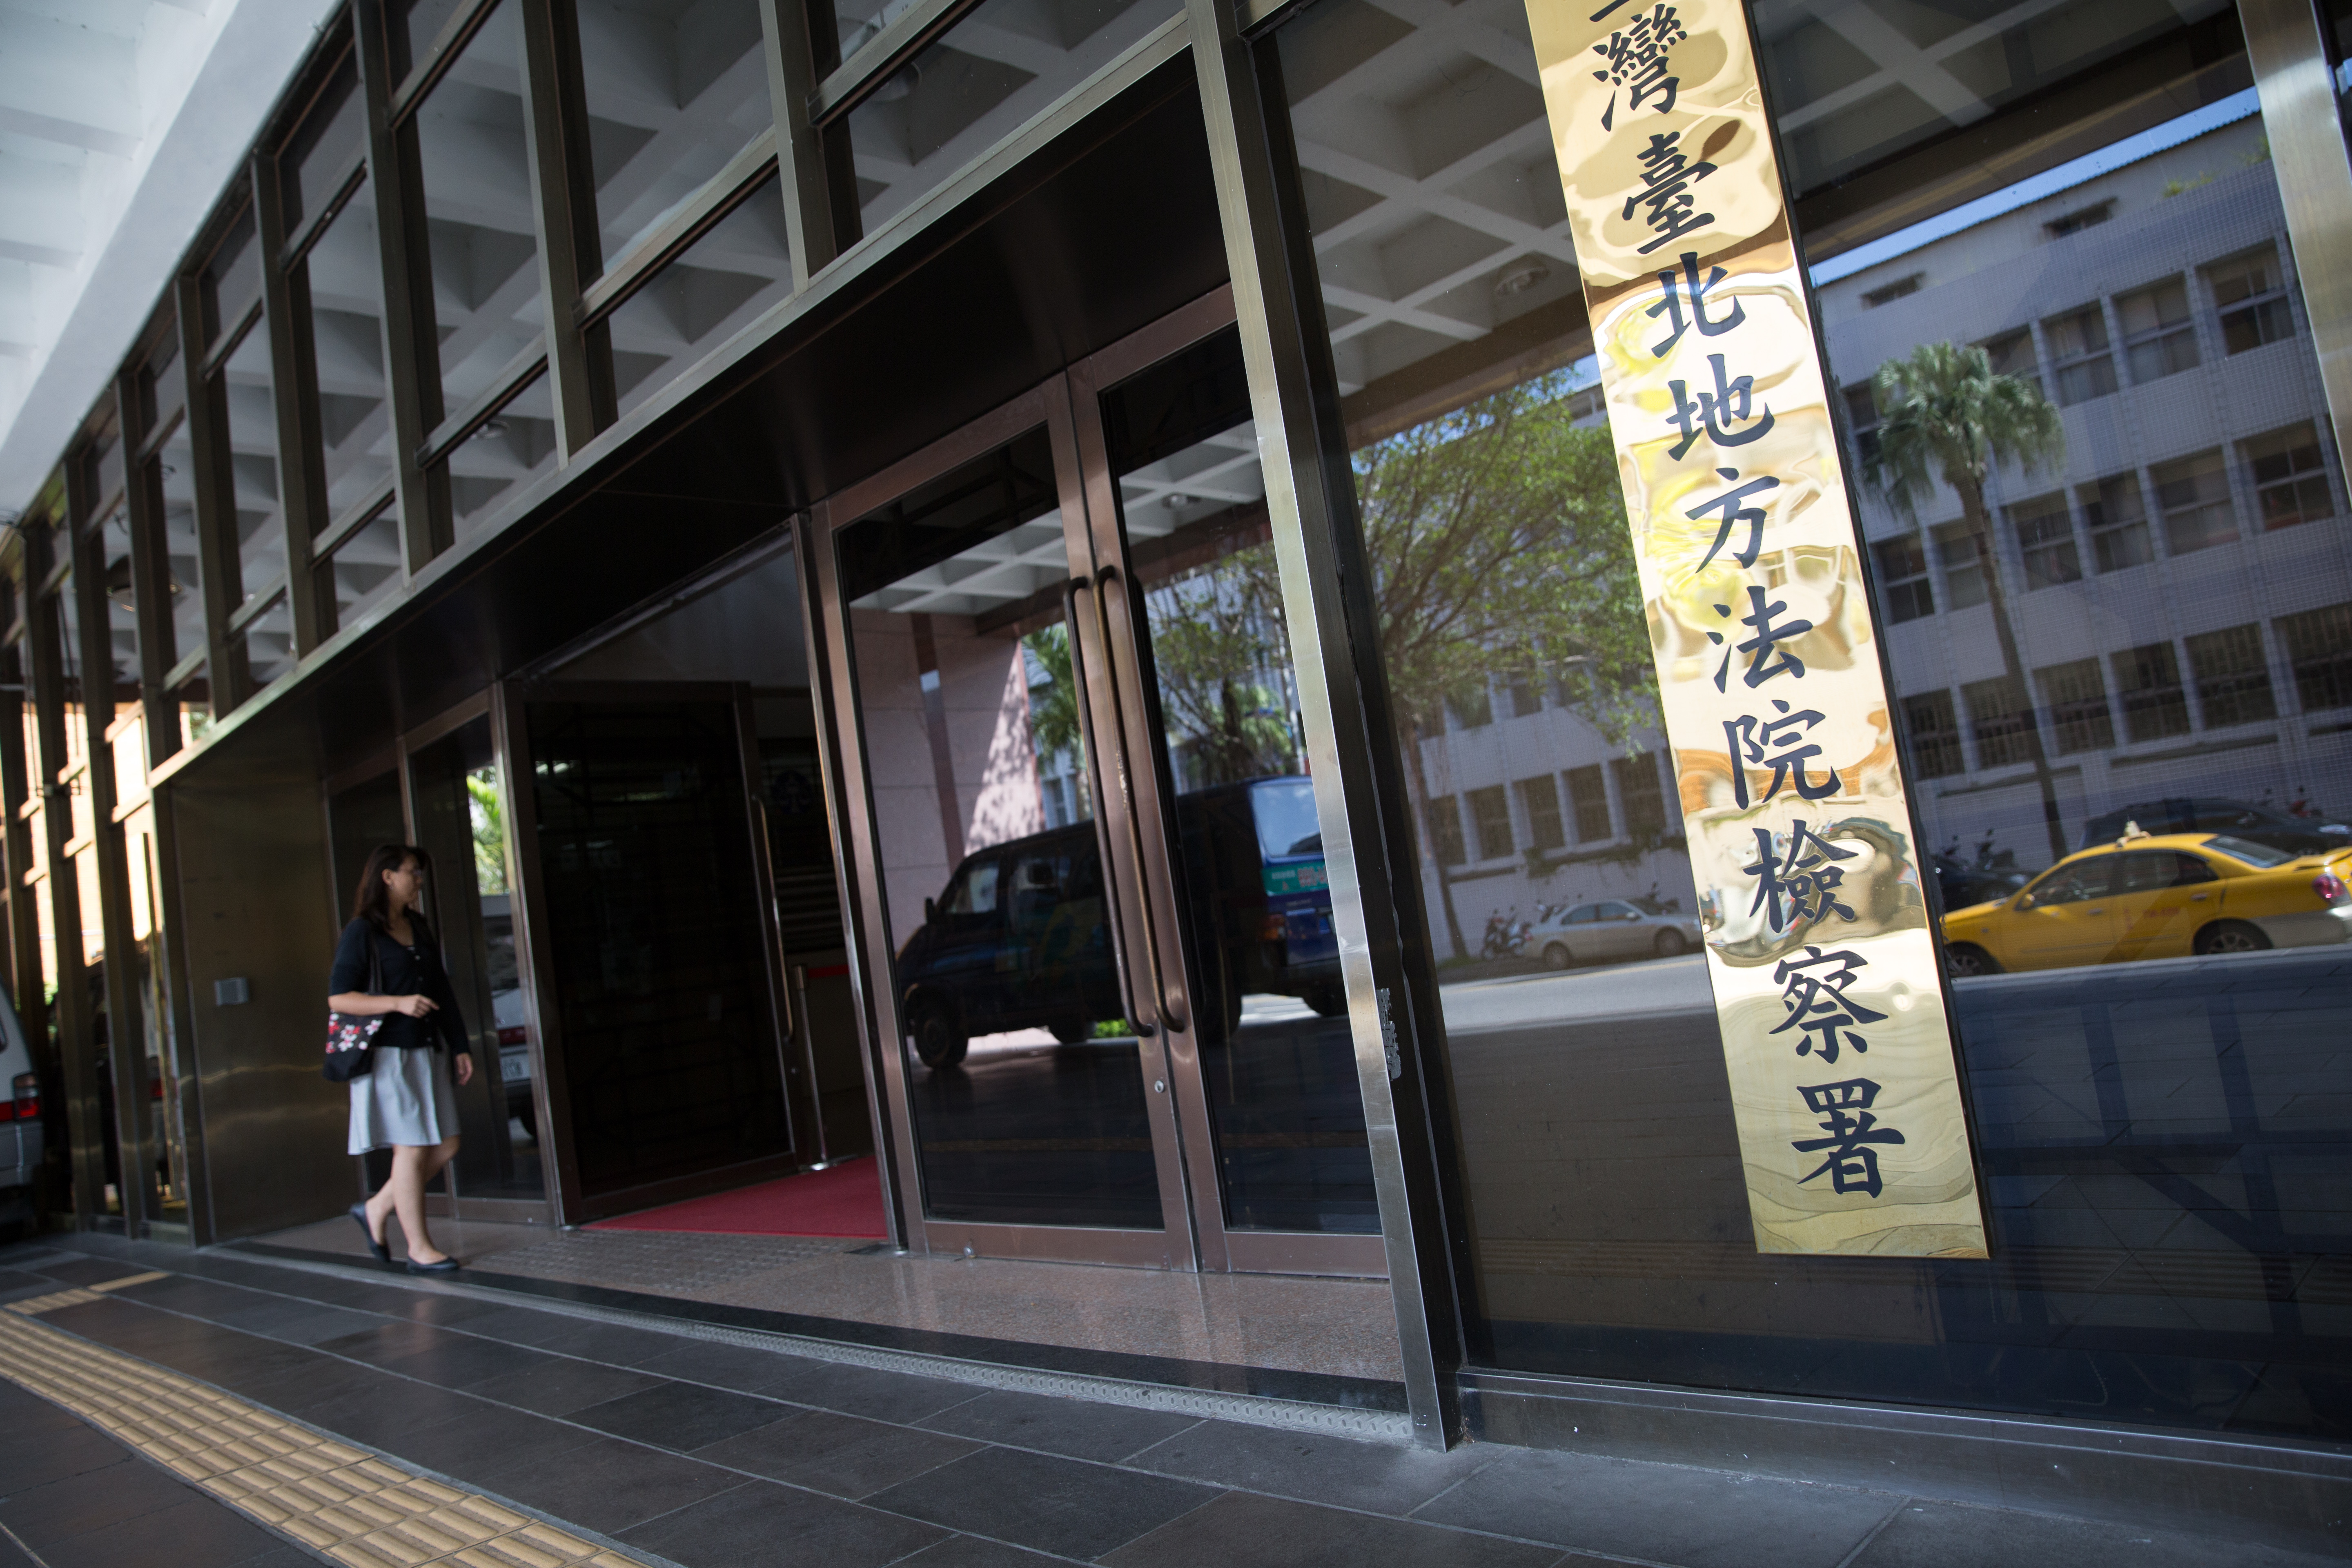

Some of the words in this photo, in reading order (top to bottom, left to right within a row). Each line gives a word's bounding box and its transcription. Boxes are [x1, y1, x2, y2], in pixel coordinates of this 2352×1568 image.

[1590, 0, 1904, 1199] 灣臺北地方法院檢察署
